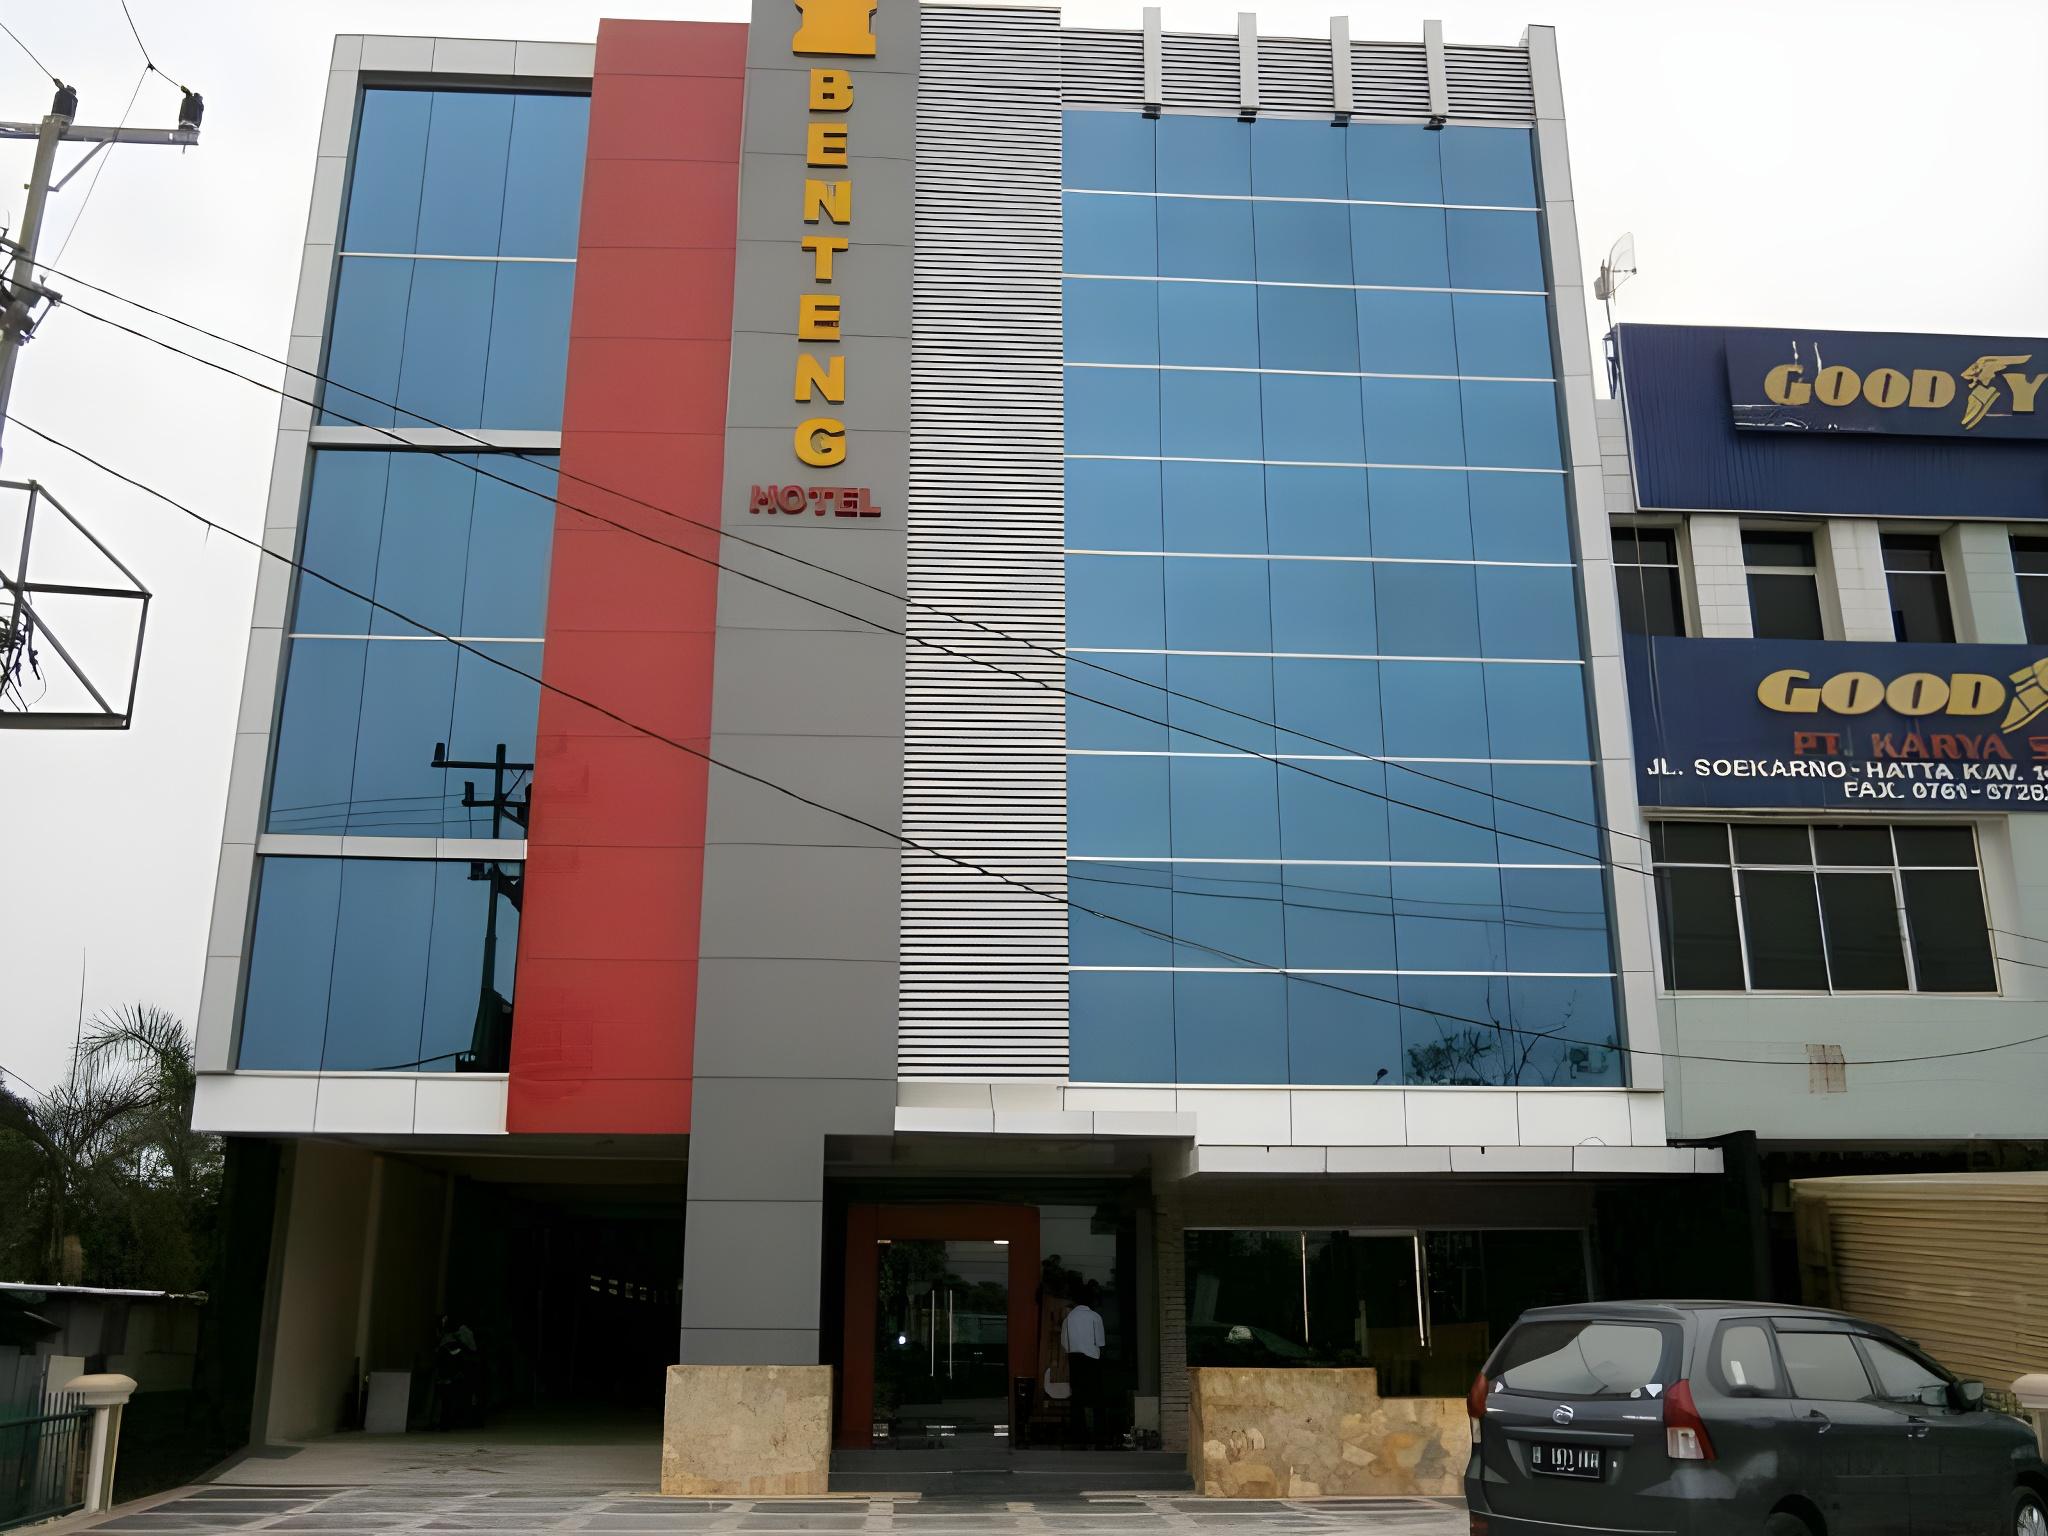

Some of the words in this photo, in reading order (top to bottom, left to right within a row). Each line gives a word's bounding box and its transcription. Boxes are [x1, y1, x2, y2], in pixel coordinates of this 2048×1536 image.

[794, 68, 854, 467] BENTENG
[750, 484, 881, 517] HOTEL
[1757, 669, 2006, 716] GOOD
[1871, 732, 2014, 760] KARYA
[1647, 757, 1684, 776] JL.
[1962, 763, 2024, 781] KAV.
